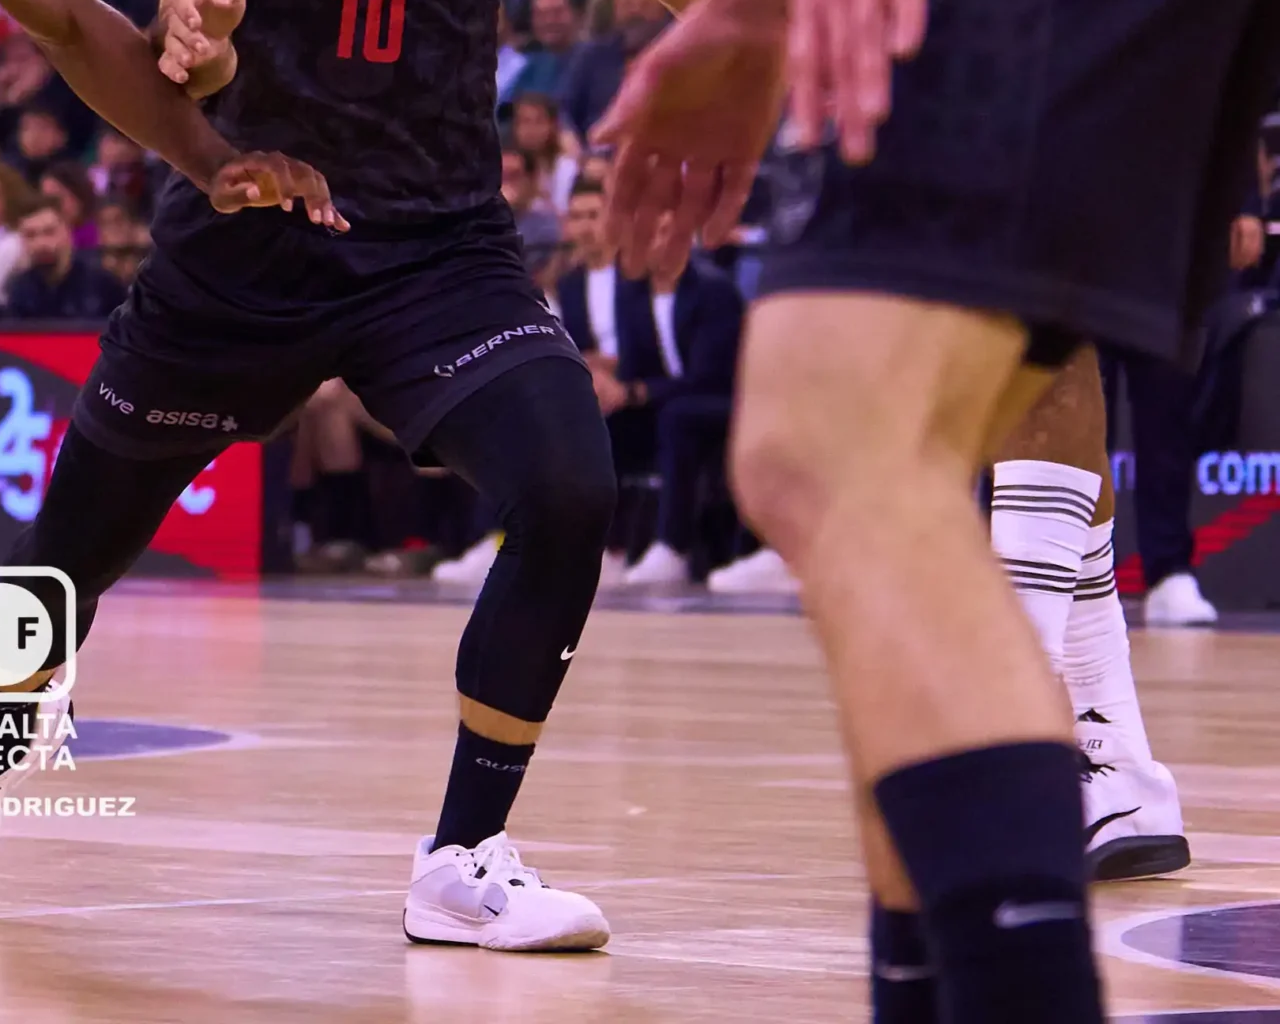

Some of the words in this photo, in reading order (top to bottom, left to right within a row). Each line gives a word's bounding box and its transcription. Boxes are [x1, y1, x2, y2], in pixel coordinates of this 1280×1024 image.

[455, 325, 556, 367] BERNER
[99, 383, 134, 415] vive
[146, 410, 219, 429] asisa
